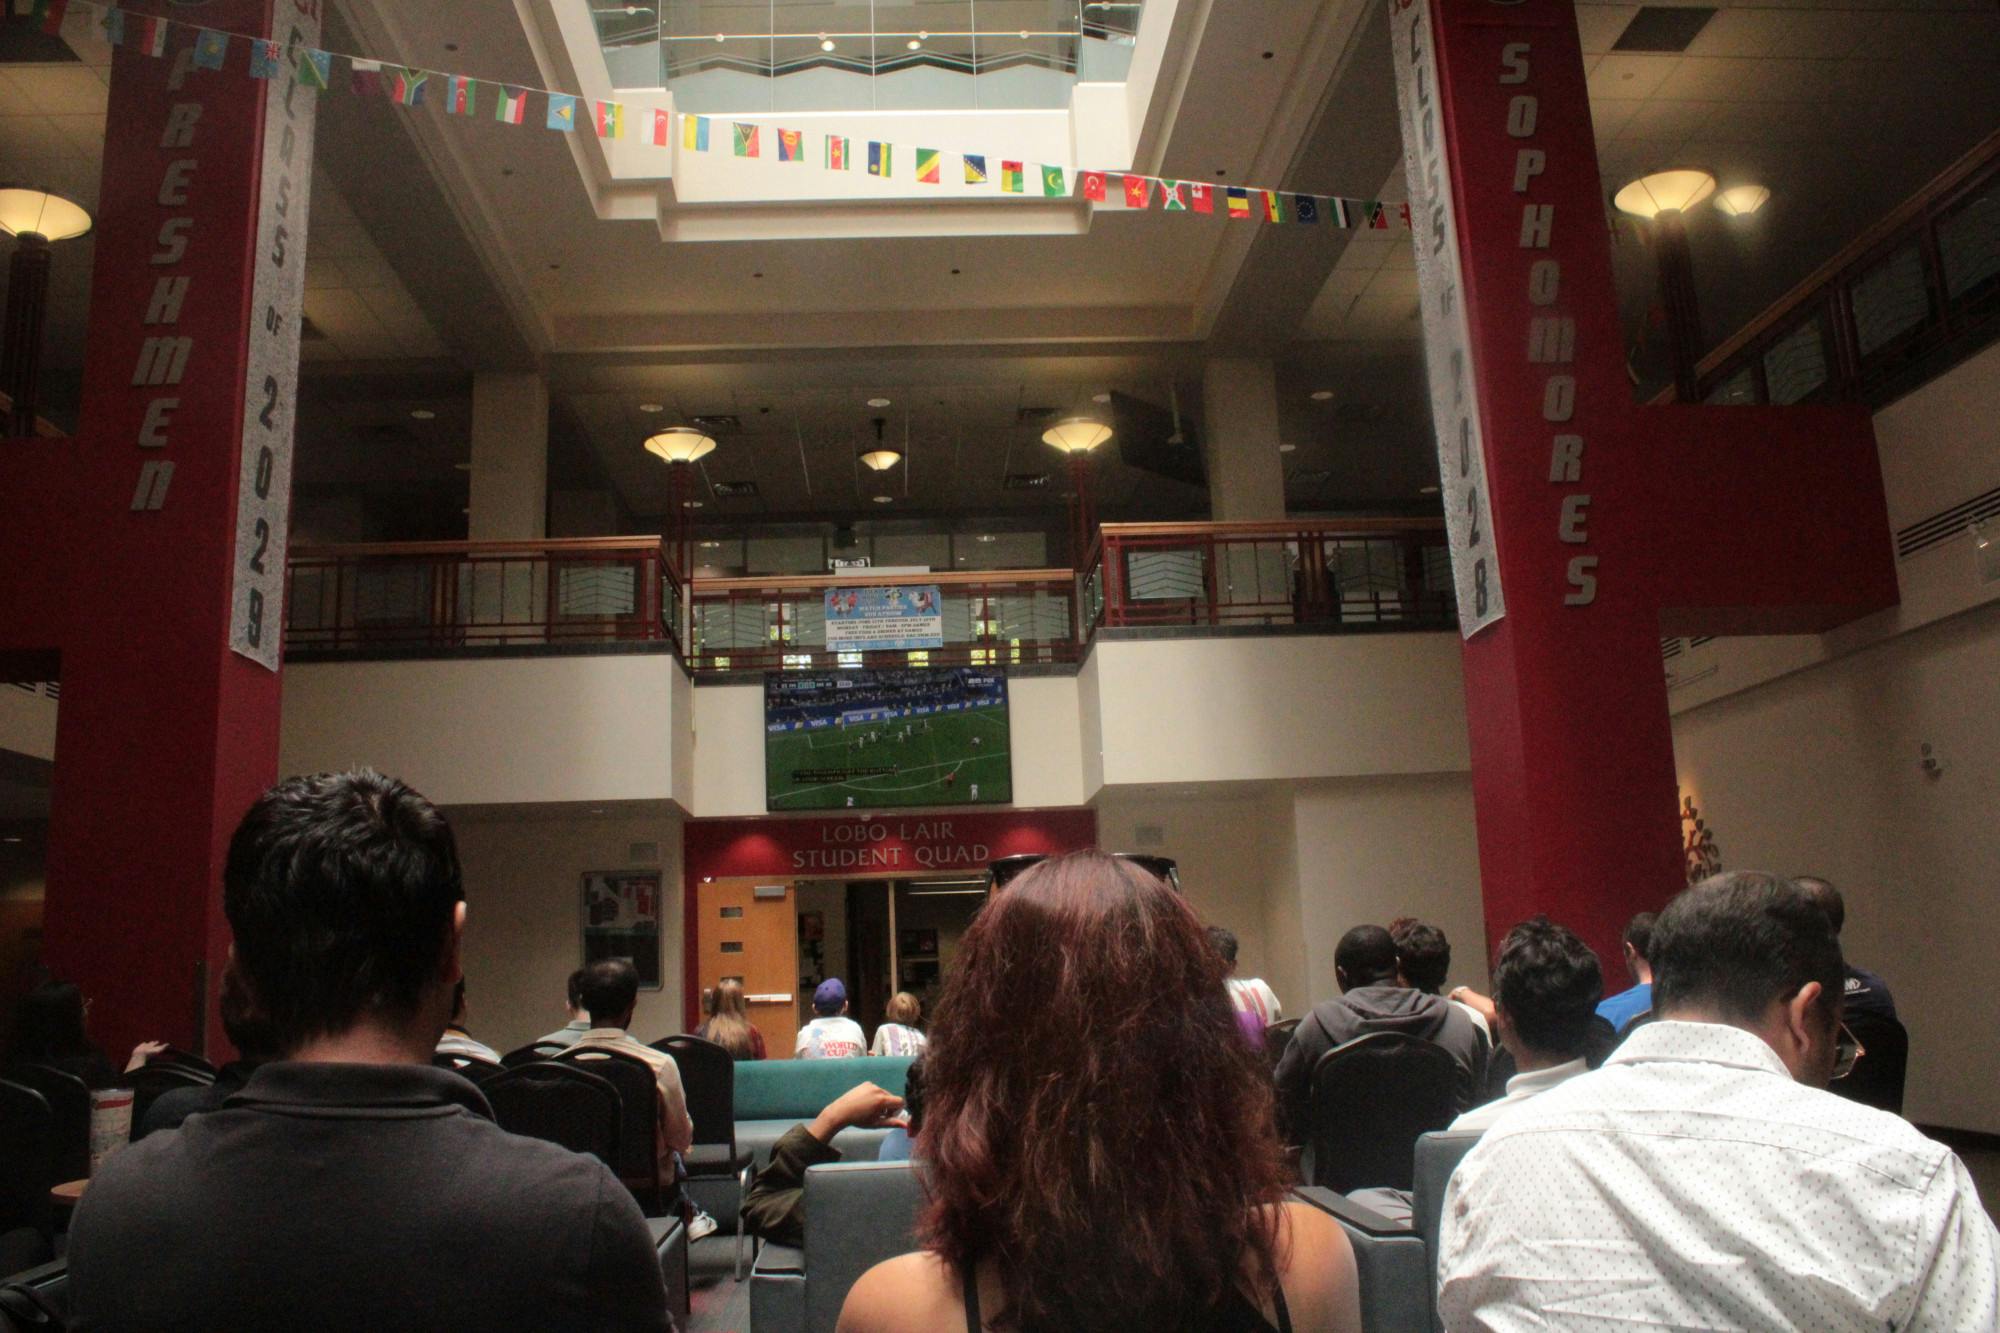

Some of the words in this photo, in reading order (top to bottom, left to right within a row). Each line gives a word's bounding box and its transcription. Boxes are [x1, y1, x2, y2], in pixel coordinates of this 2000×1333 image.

[271, 25, 302, 269] CLASS
[265, 303, 284, 338] OF
[1410, 13, 1446, 257] CLASS
[1450, 346, 1488, 619] 2028
[1498, 42, 1600, 606] SOPHOMORES
[246, 374, 280, 649] 2029
[810, 719, 827, 727] VISA
[848, 714, 864, 722] VISA
[822, 823, 887, 843] LOBO
[900, 821, 955, 840] LAIR
[792, 847, 903, 868] STUDENT
[914, 843, 989, 868] QUAD
[823, 1041, 858, 1051] WORLD
[827, 1049, 848, 1057] CUP
